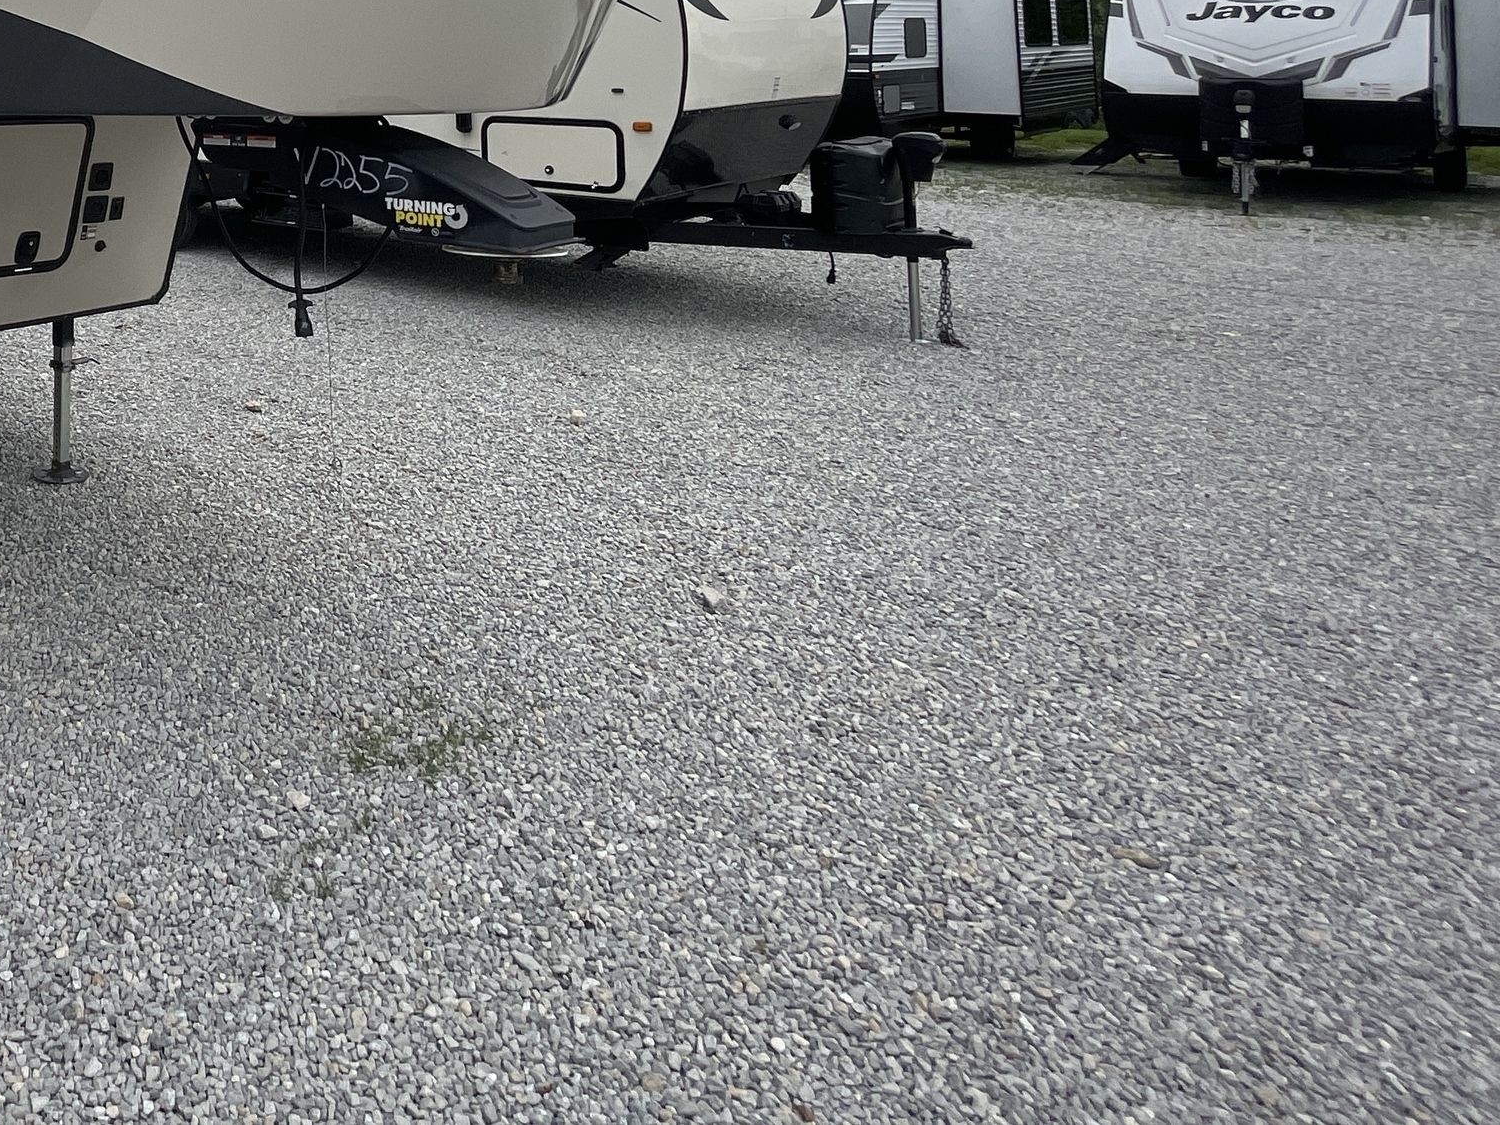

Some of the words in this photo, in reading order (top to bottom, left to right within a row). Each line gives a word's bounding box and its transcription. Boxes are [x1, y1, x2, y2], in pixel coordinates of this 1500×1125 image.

[1186, 2, 1336, 24] Jayco
[384, 196, 456, 216] TURNING
[395, 211, 445, 228] POINT
